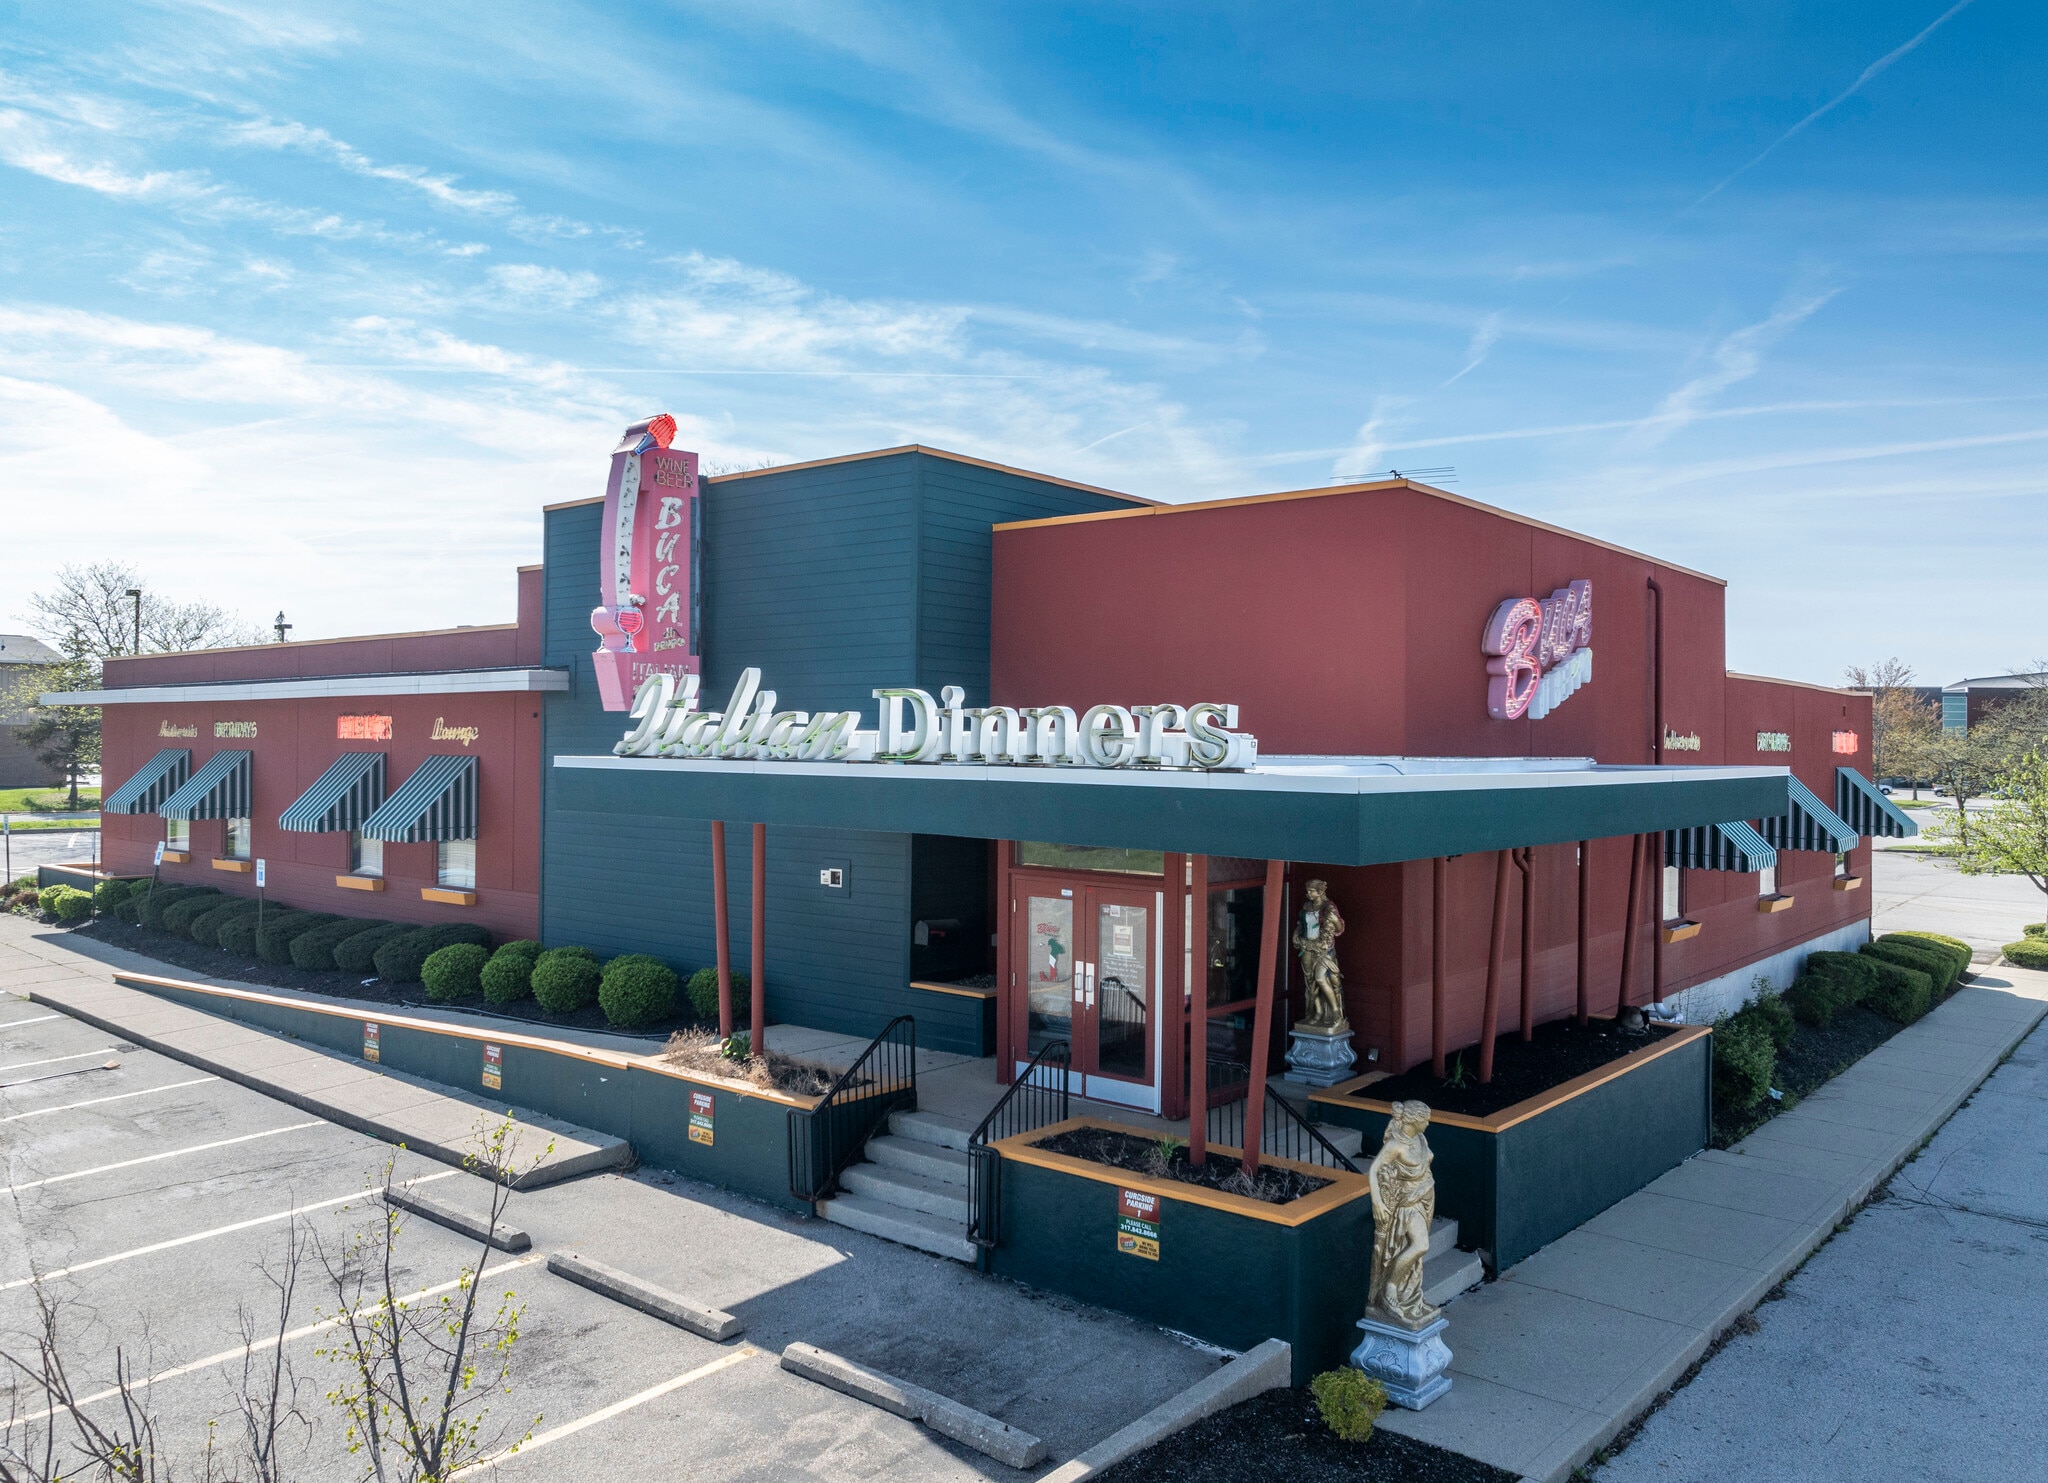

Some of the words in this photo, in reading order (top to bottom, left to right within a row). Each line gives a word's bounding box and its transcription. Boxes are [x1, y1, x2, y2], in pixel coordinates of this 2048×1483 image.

[656, 456, 690, 475] WINE
[656, 470, 693, 488] BEER
[654, 496, 684, 624] BUCA
[612, 667, 861, 760] Italian
[872, 685, 1239, 769] Dinners
[1125, 1191, 1155, 1204] CURBSIDE
[1126, 1199, 1154, 1212] PARKING
[1137, 1210, 1141, 1218] 1
[1125, 1219, 1141, 1228] PLEASE
[1141, 1222, 1152, 1231] CALL
